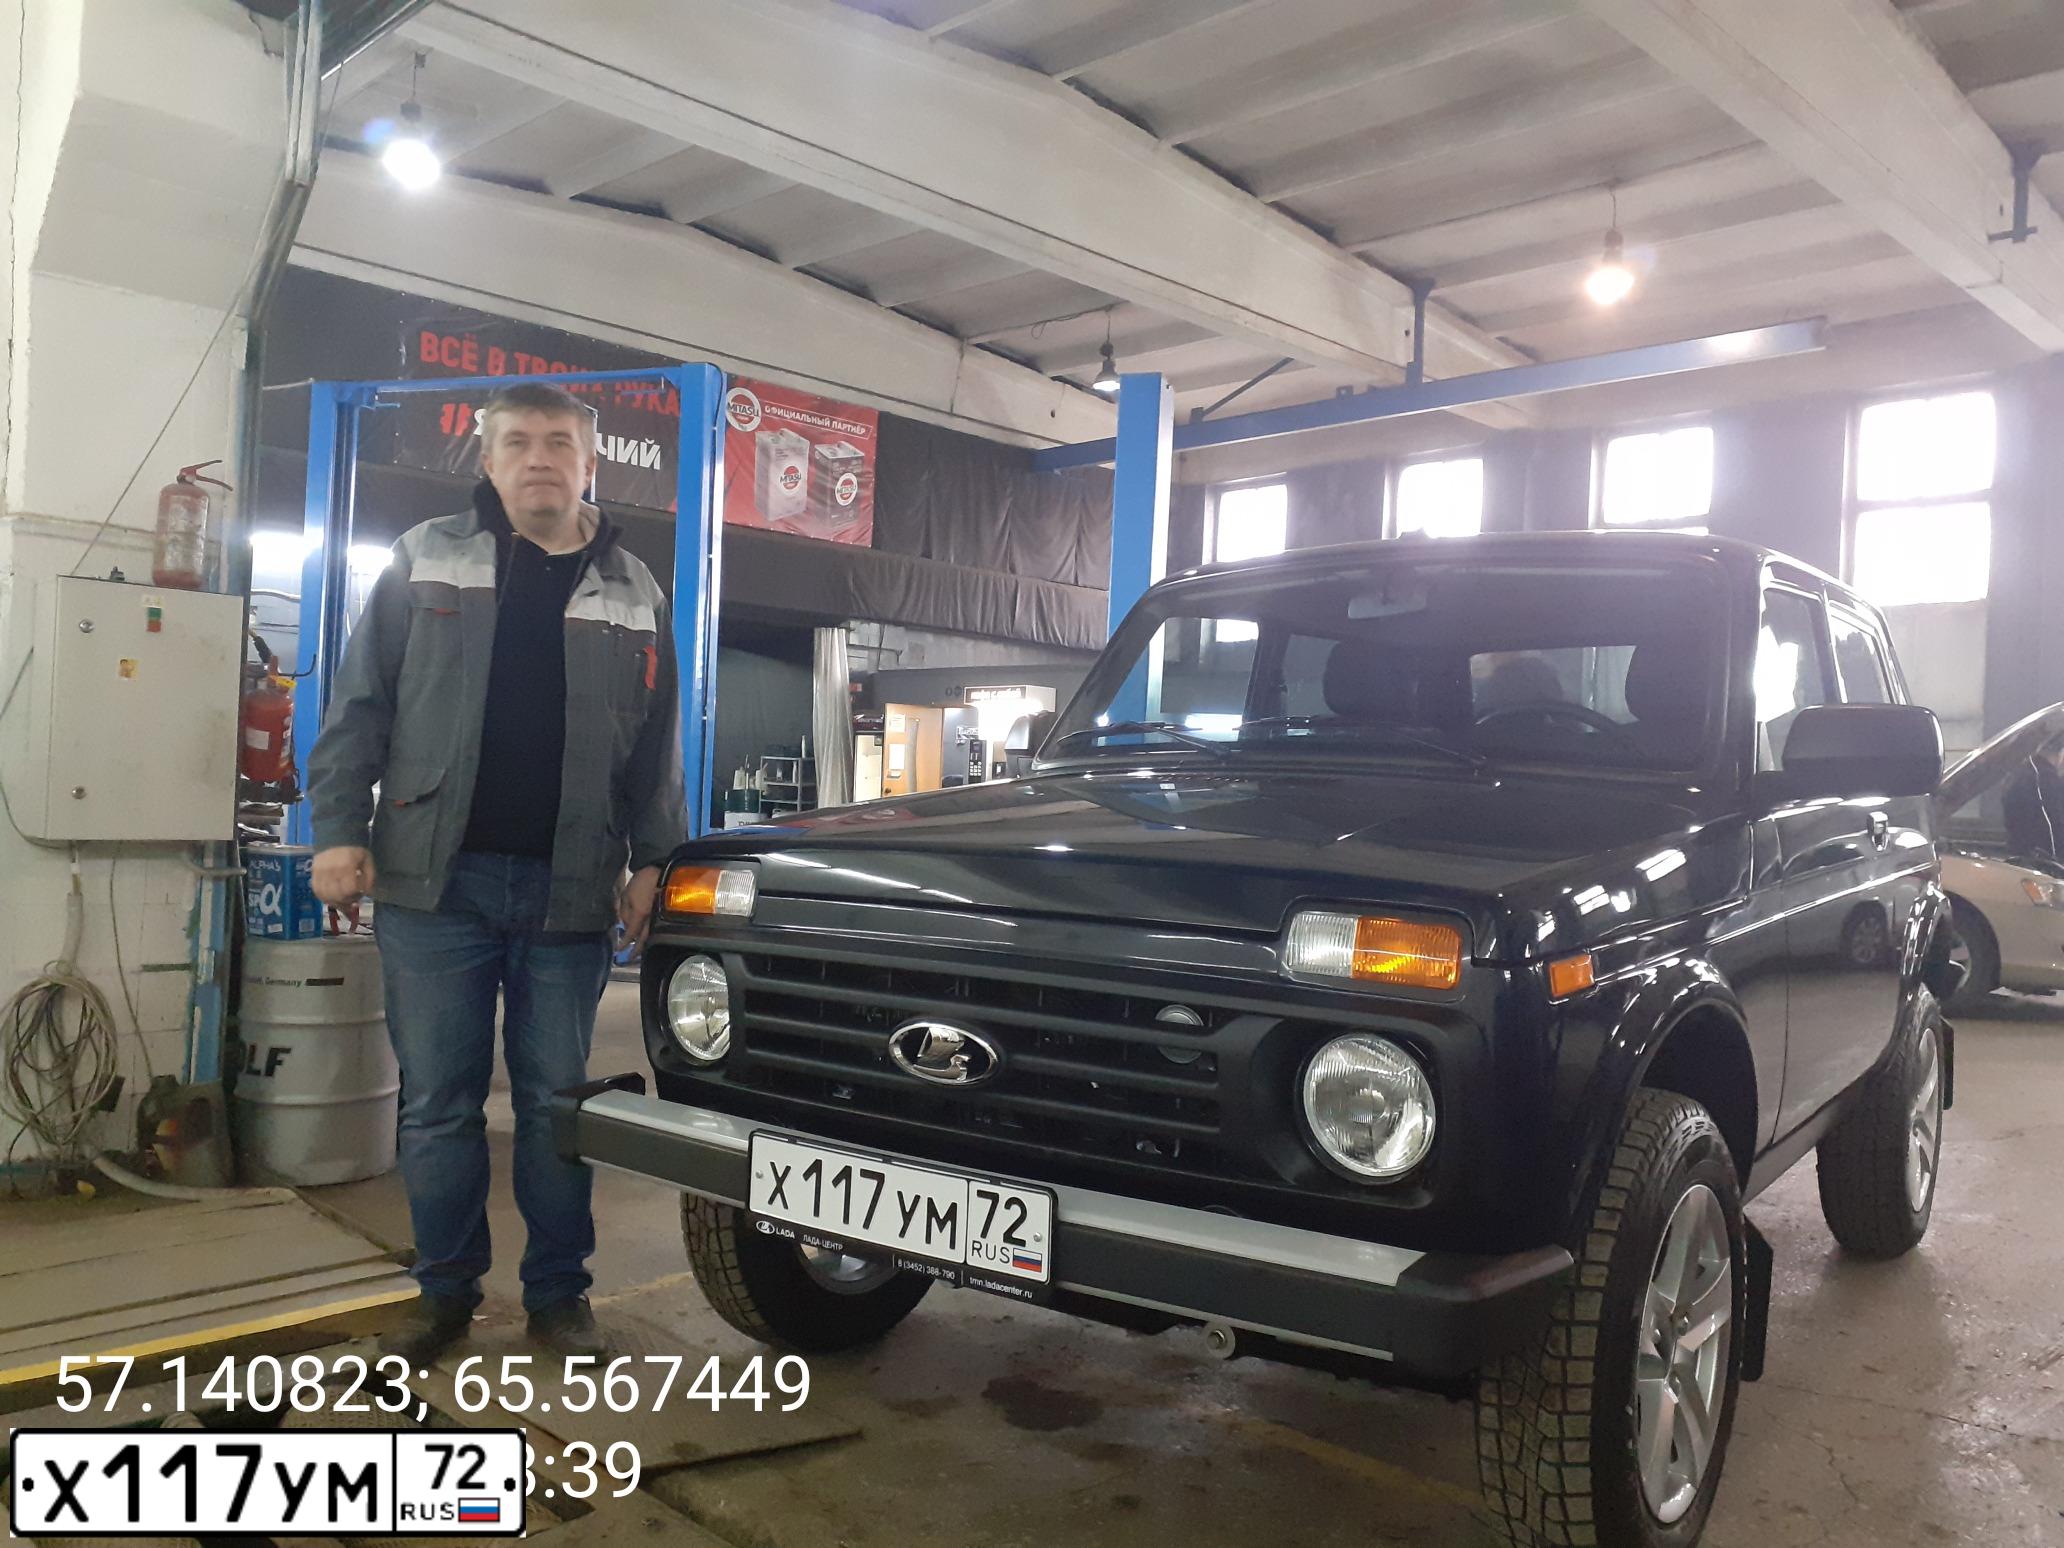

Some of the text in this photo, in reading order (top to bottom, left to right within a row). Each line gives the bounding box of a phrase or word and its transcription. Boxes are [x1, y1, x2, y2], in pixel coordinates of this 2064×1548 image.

[420, 331, 479, 373] ВСЁ
[486, 346, 505, 376] В
[727, 402, 761, 418] MITASU
[764, 405, 831, 428] ОФИЦИАЛЬНЫЙ
[832, 420, 867, 435] ПАРТНЁР
[246, 1043, 292, 1077] LF
[976, 1189, 1028, 1248] 72
[776, 1227, 796, 1239] LADA
[802, 1234, 844, 1251] ЛАДА-ЦЕНТР
[971, 1240, 1010, 1264] RUS
[903, 1260, 926, 1275] (3452)
[926, 1265, 956, 1280] 388-790
[969, 1276, 1033, 1299] tmn.ladacenter.ru
